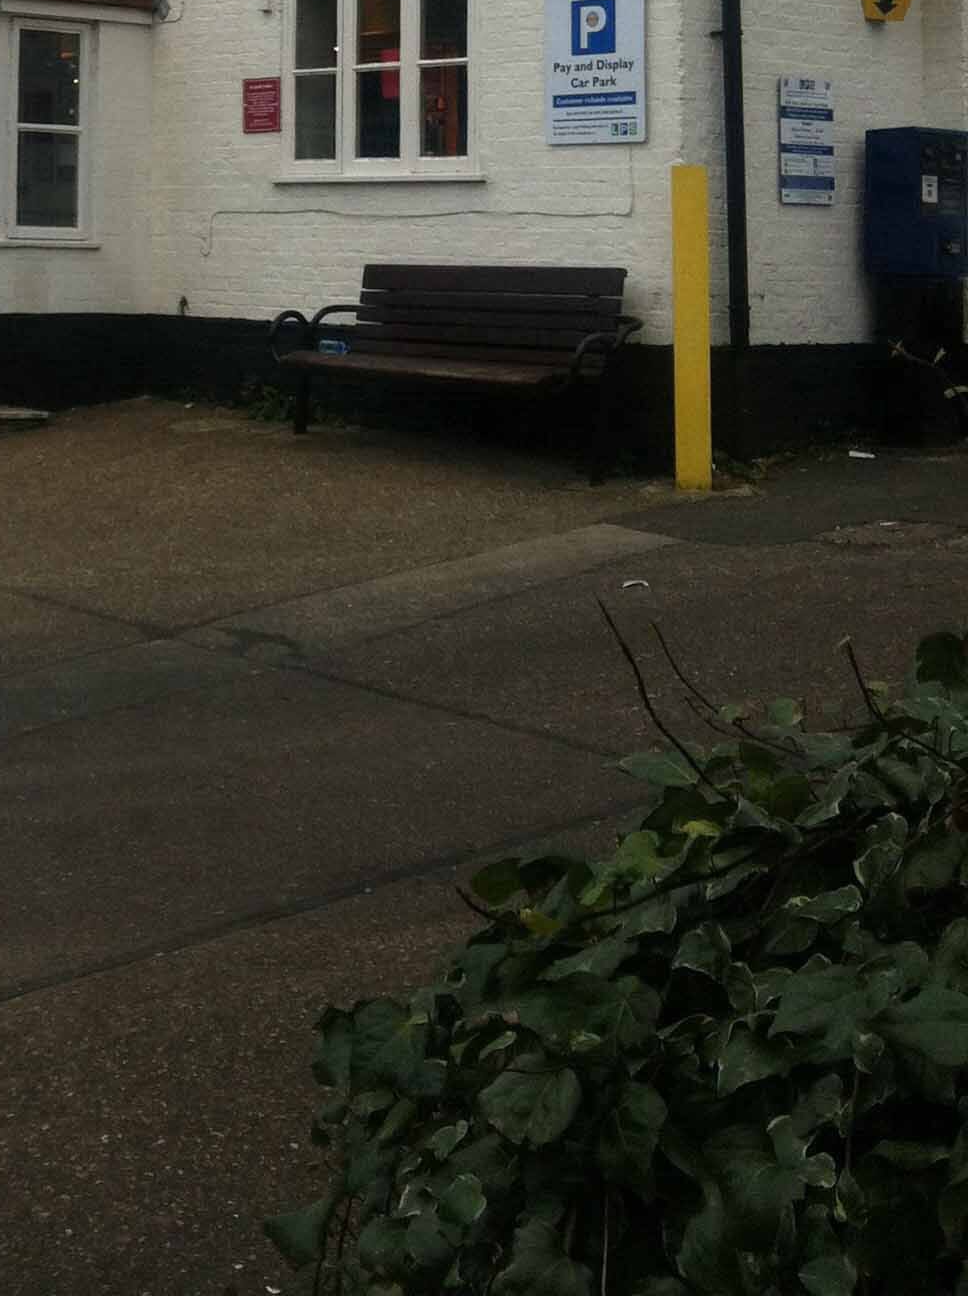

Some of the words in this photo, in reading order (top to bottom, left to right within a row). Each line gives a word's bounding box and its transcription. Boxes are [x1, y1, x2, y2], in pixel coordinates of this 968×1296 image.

[580, 6, 607, 48] P
[553, 62, 571, 76] Pay
[575, 61, 593, 72] and
[596, 58, 634, 73] Display
[571, 77, 590, 89] Car
[592, 75, 617, 87] Park
